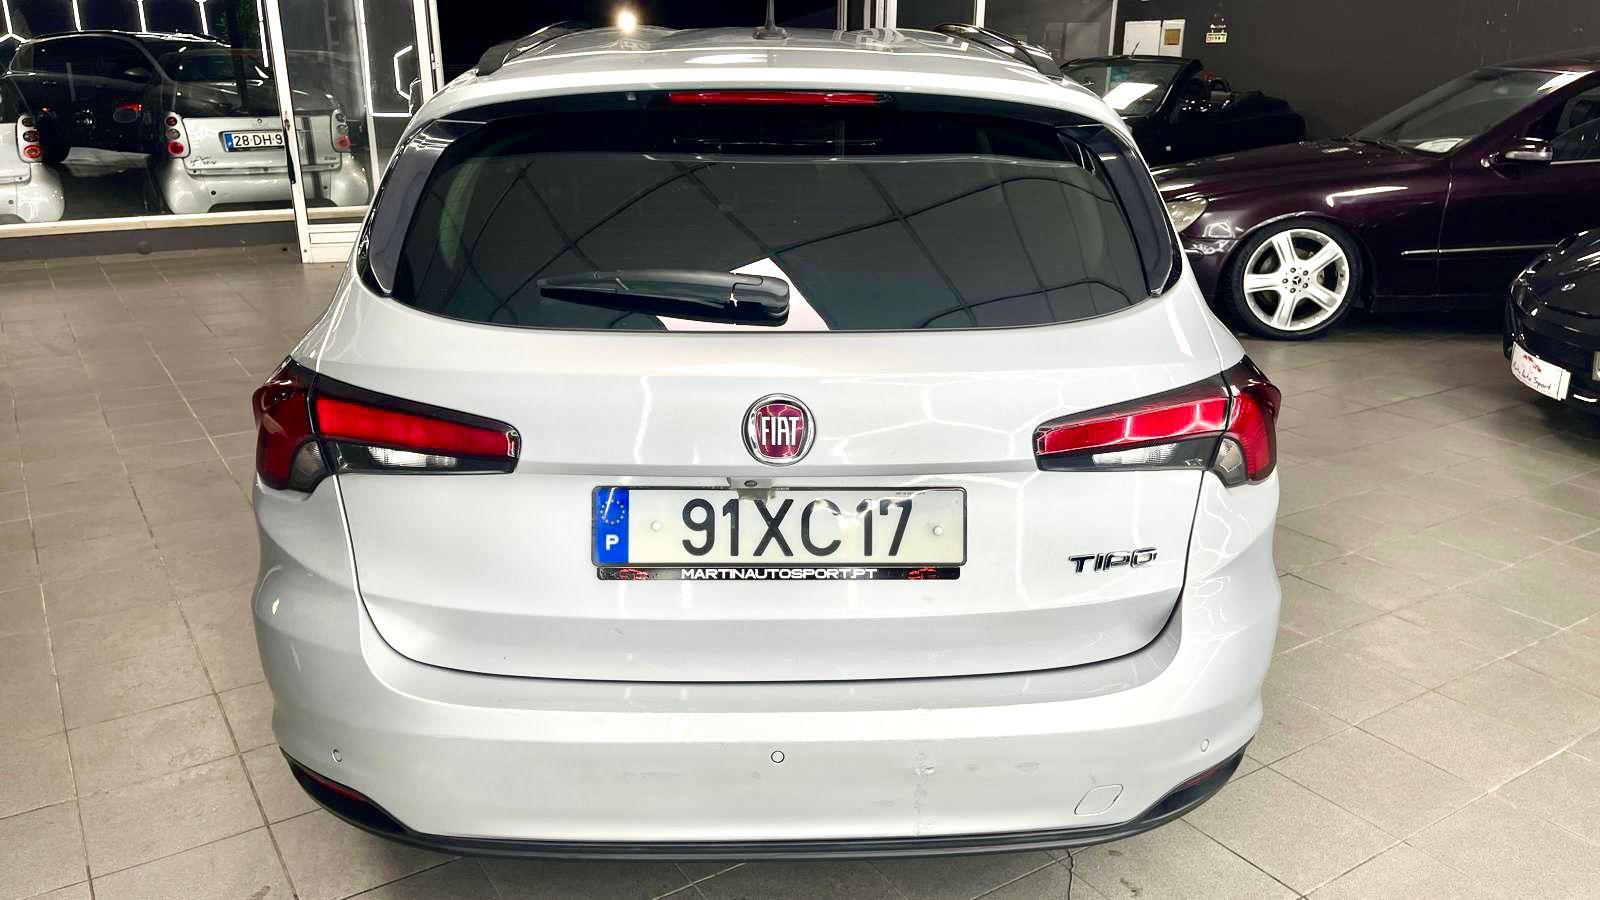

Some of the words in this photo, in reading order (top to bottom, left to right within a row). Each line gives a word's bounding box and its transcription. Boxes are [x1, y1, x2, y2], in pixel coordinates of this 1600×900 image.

[761, 416, 800, 445] FIAT
[605, 534, 620, 551] P
[1068, 545, 1158, 573] TIPO
[680, 567, 879, 581] MARTINAUTOSPORT.PT
